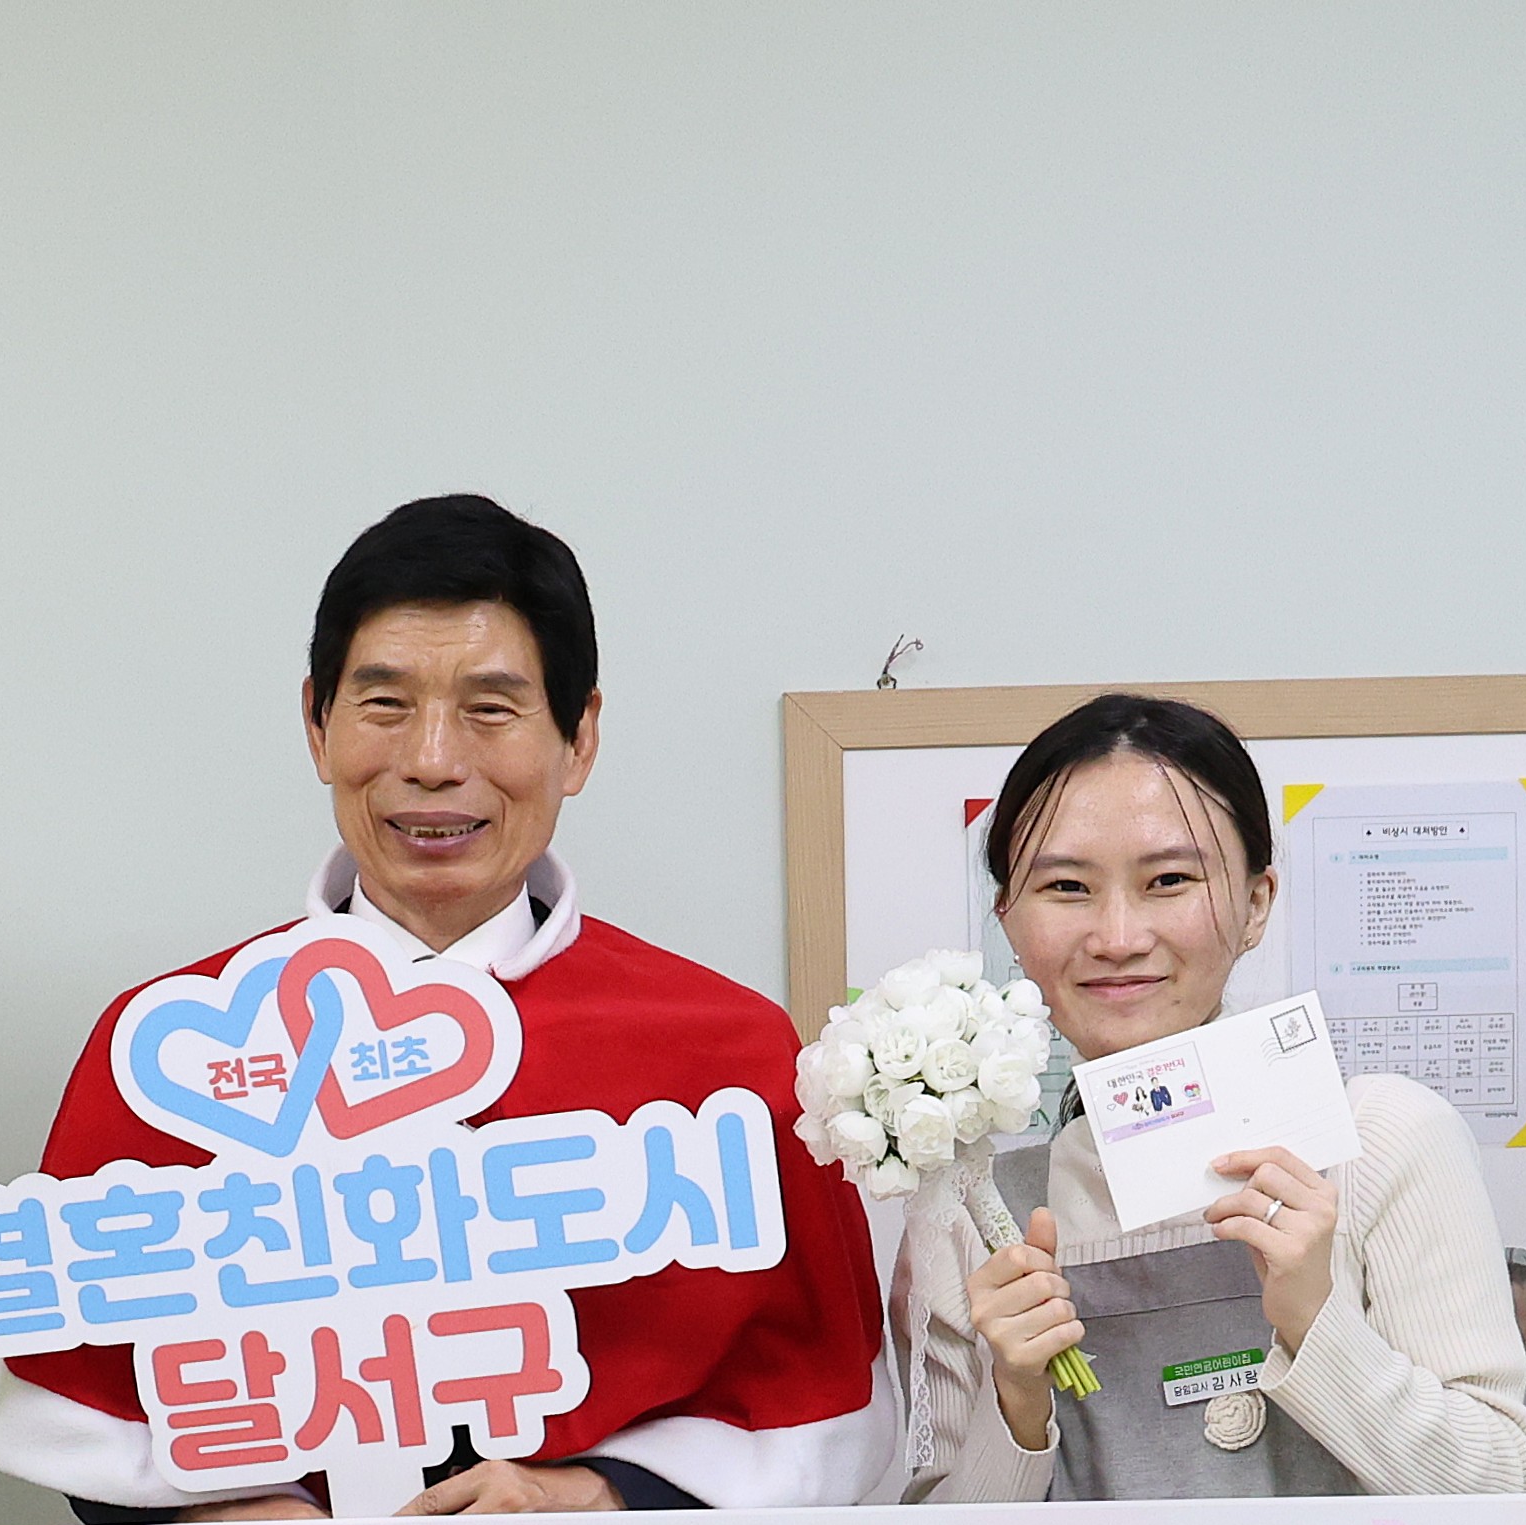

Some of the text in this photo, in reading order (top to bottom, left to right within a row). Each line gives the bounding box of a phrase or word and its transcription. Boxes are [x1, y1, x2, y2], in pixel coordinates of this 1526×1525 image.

[1381, 824, 1448, 838] 비상시 대처방안
[207, 1036, 432, 1101] 전국 최초
[1107, 1070, 1145, 1089] 대한민국
[152, 1301, 564, 1472] 달서구
